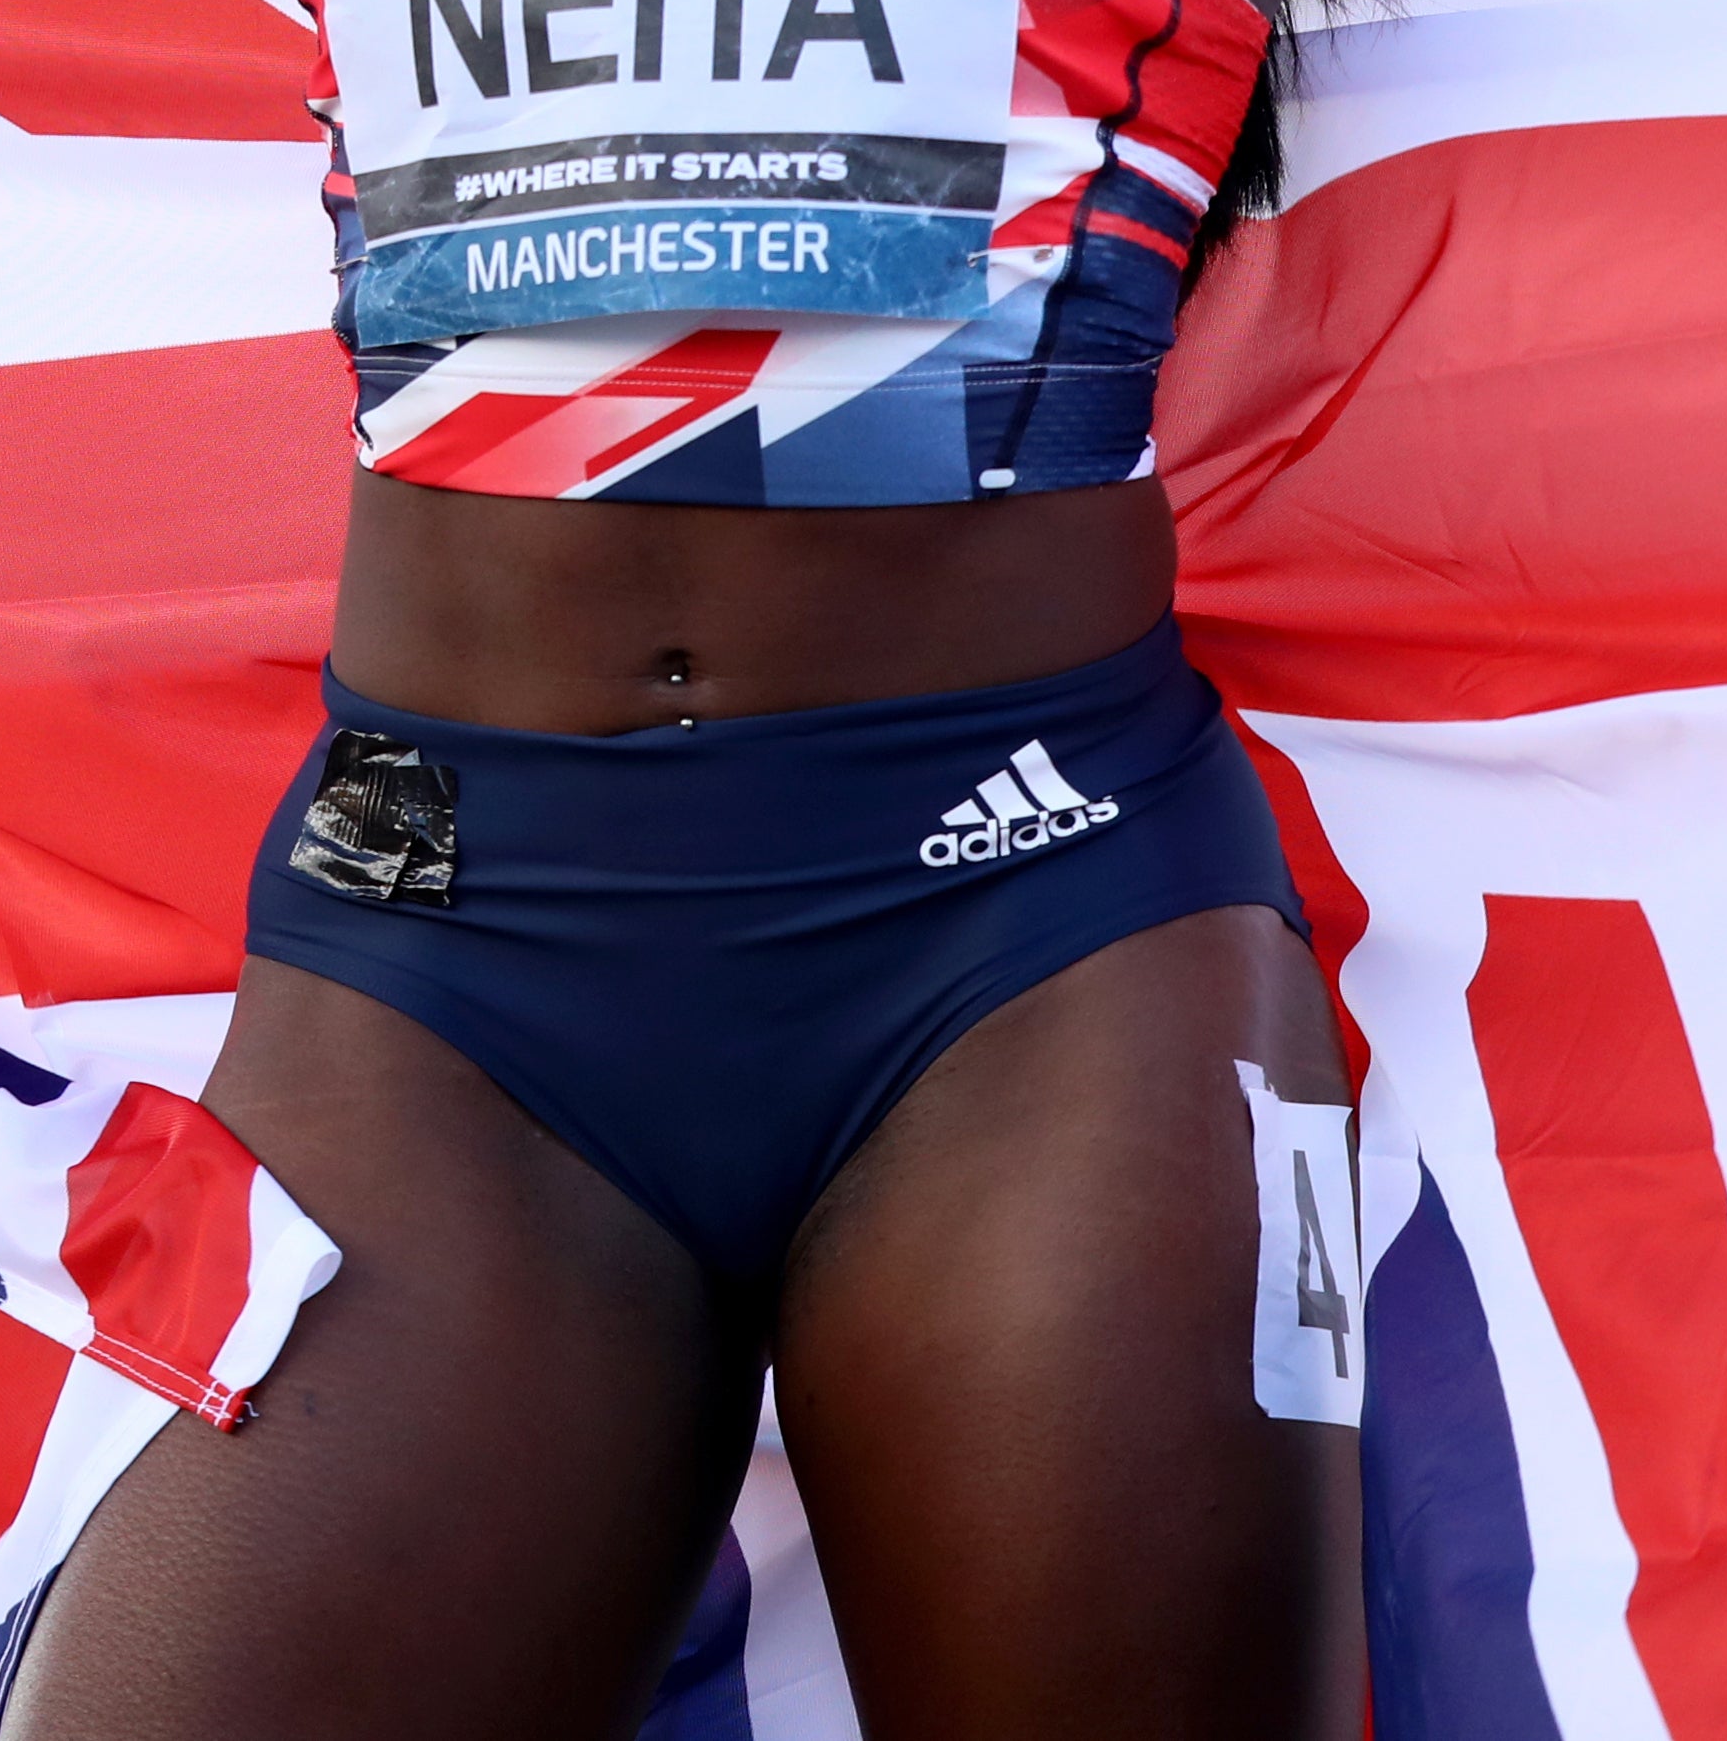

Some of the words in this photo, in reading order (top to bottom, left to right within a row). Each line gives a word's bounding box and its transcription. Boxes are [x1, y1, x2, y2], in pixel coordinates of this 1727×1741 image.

[455, 156, 617, 202] #WHERE
[624, 154, 666, 181] IT
[671, 152, 848, 182] STARTS
[466, 220, 830, 294] MANCHESTER
[919, 795, 1120, 867] adidas
[1293, 1149, 1350, 1379] 4
